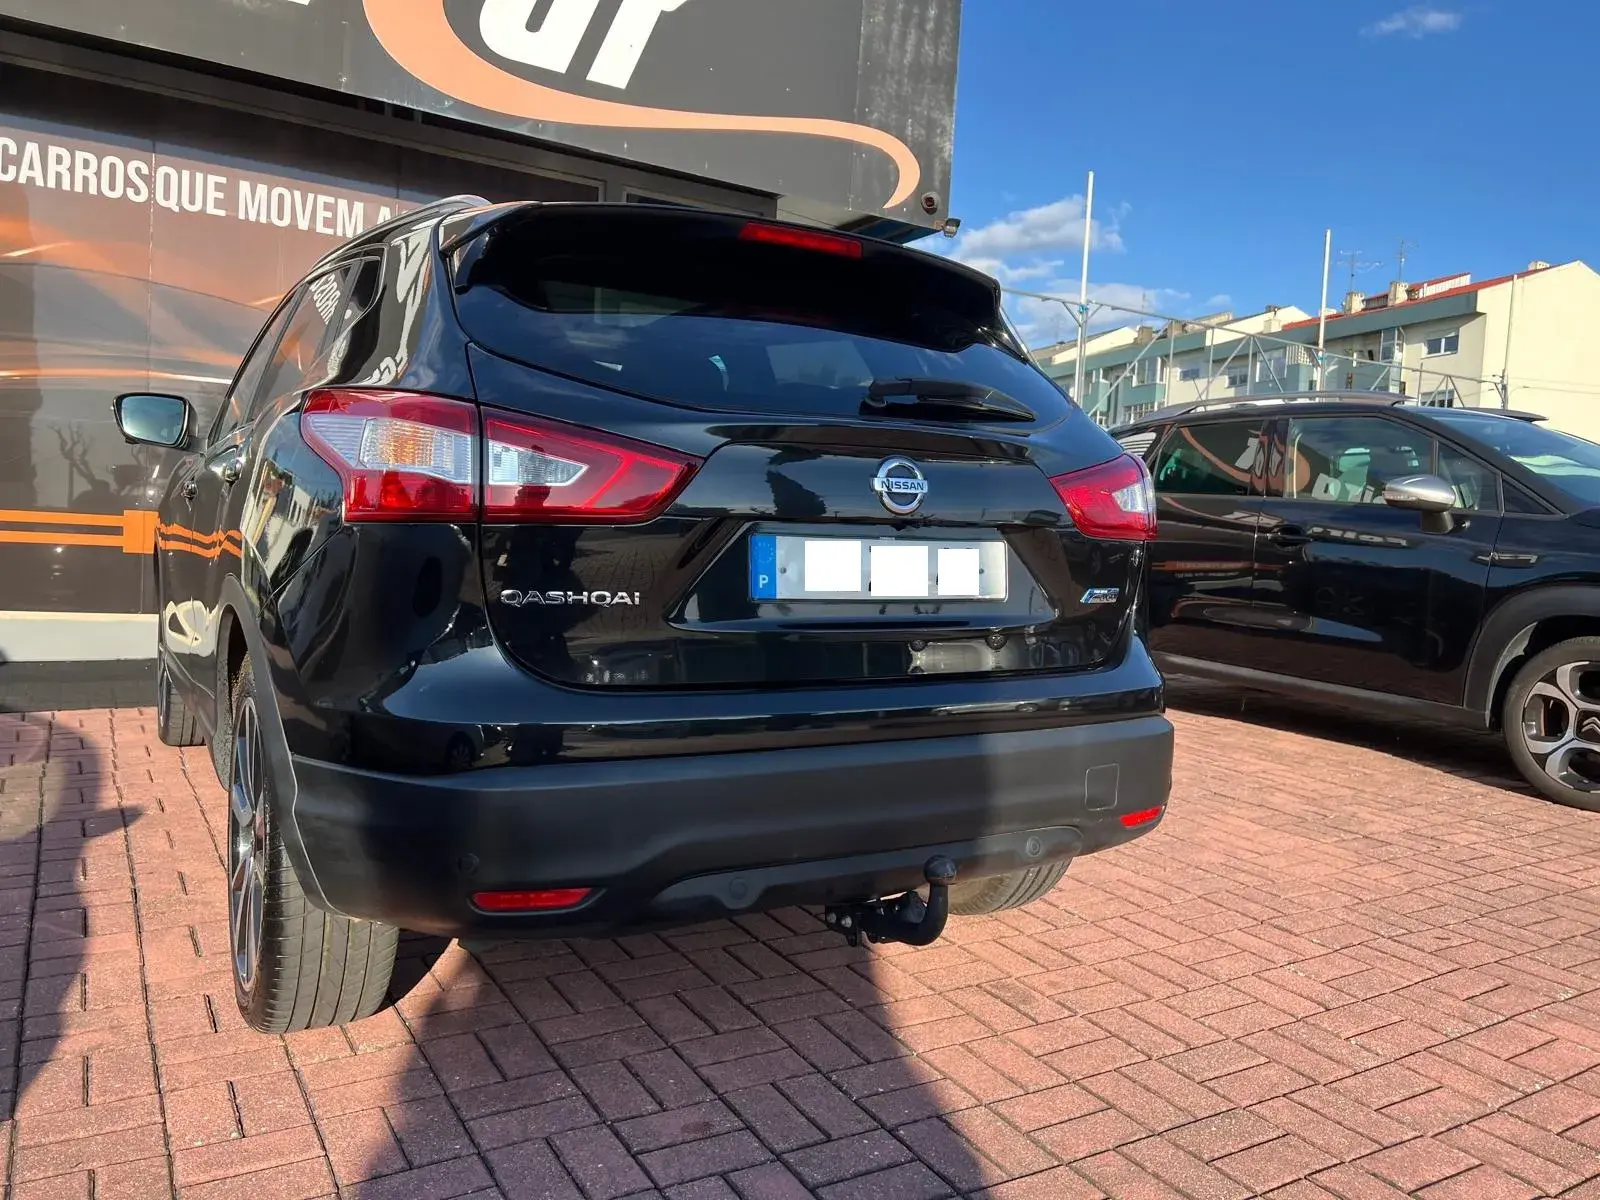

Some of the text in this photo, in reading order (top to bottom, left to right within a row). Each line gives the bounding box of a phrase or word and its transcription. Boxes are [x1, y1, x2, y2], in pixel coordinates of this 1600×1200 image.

[0, 137, 149, 203] CARROS
[155, 166, 227, 216] QUE
[238, 180, 364, 239] MOVEM
[881, 479, 924, 491] NISSAN
[759, 574, 769, 589] P
[500, 589, 641, 608] QASHQAI
